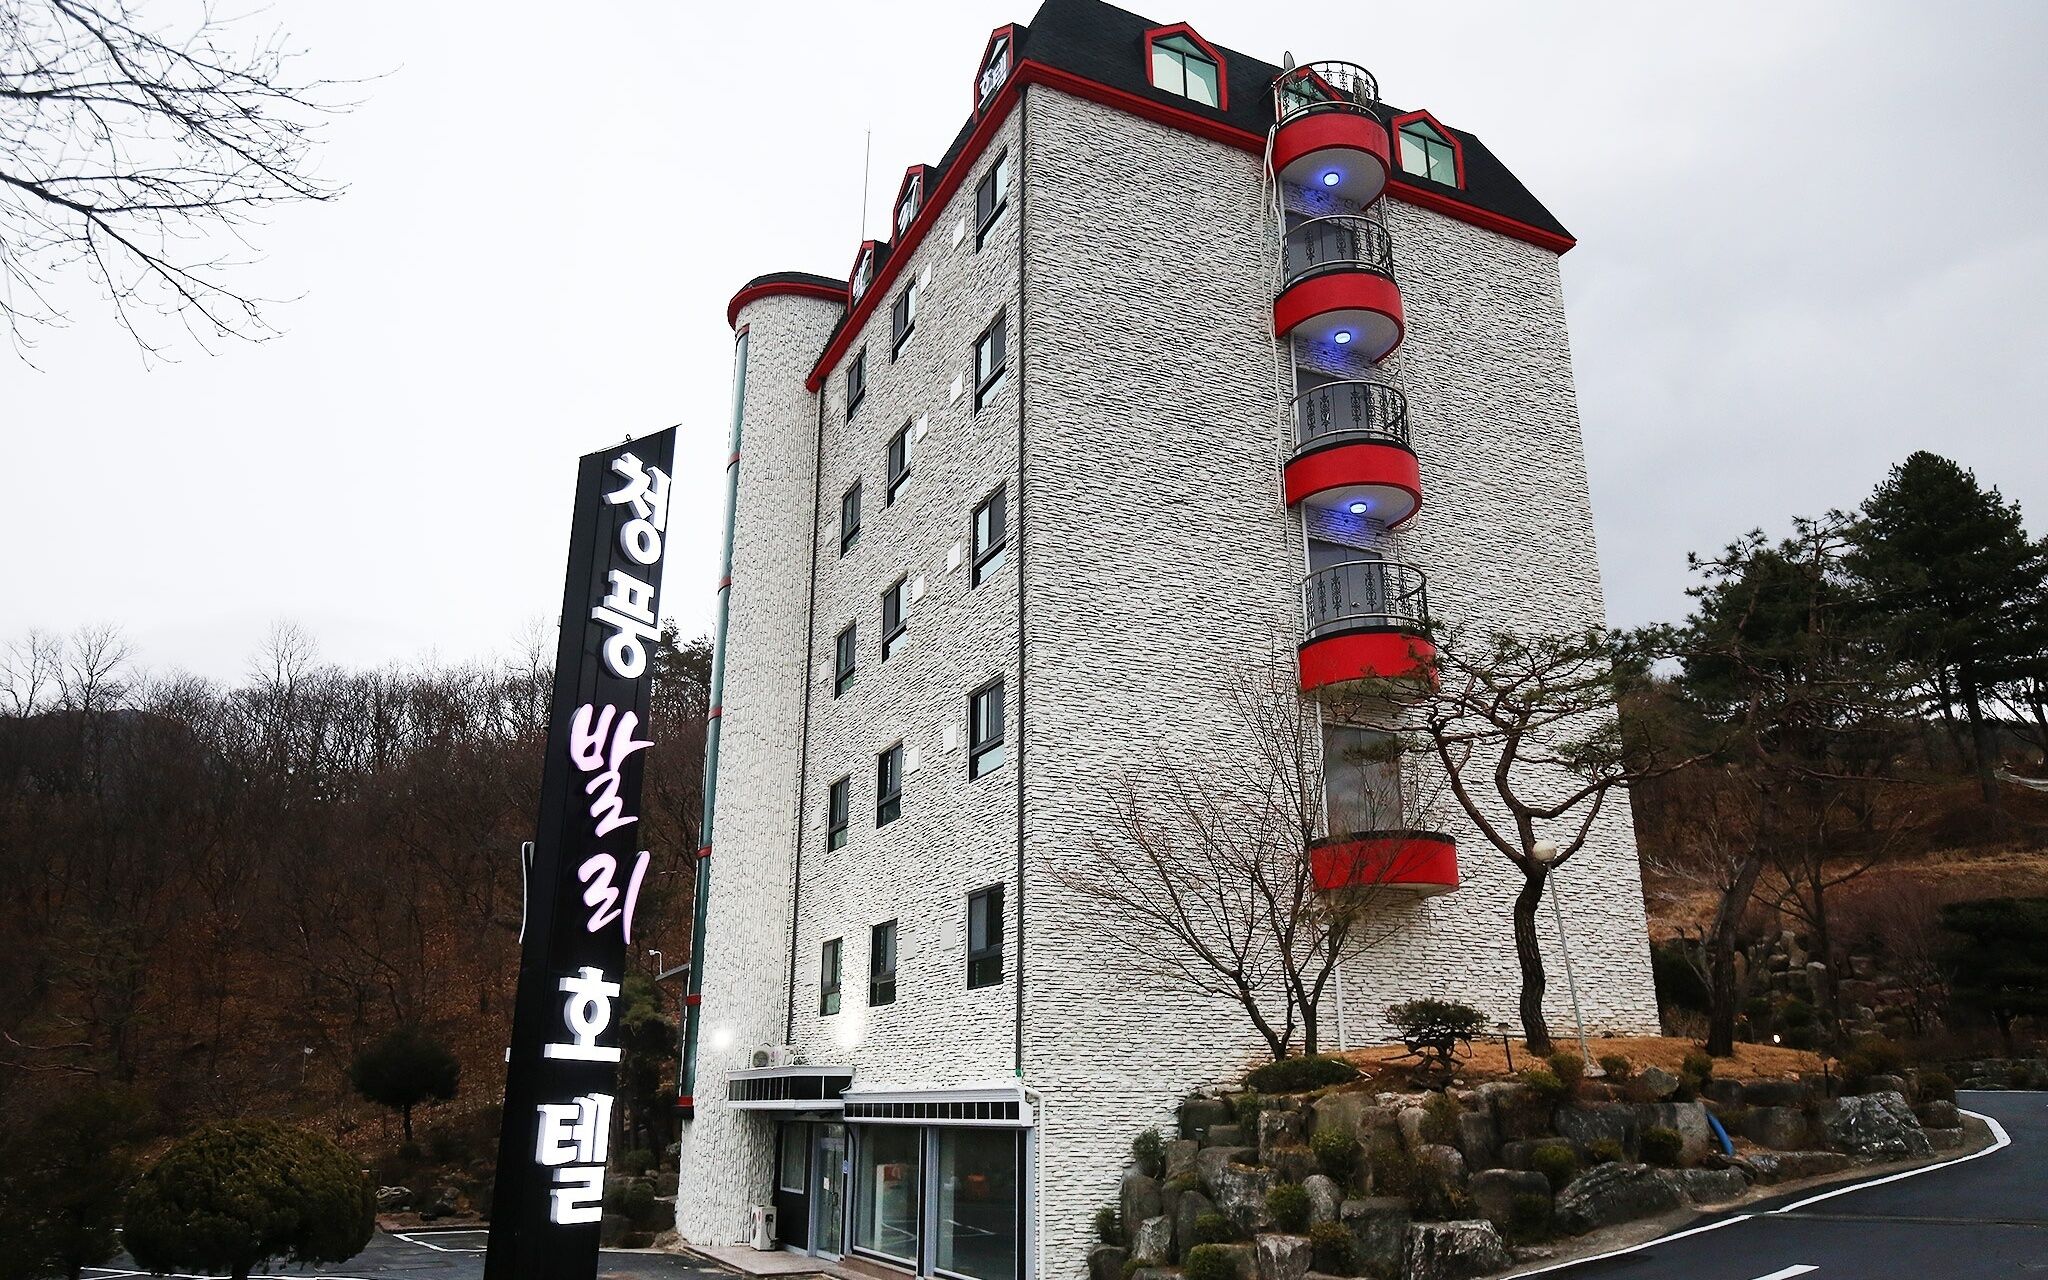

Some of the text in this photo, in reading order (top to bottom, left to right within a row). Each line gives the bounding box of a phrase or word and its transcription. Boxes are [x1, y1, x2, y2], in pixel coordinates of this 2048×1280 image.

[535, 451, 672, 1225] 청풍 발리 호텔
